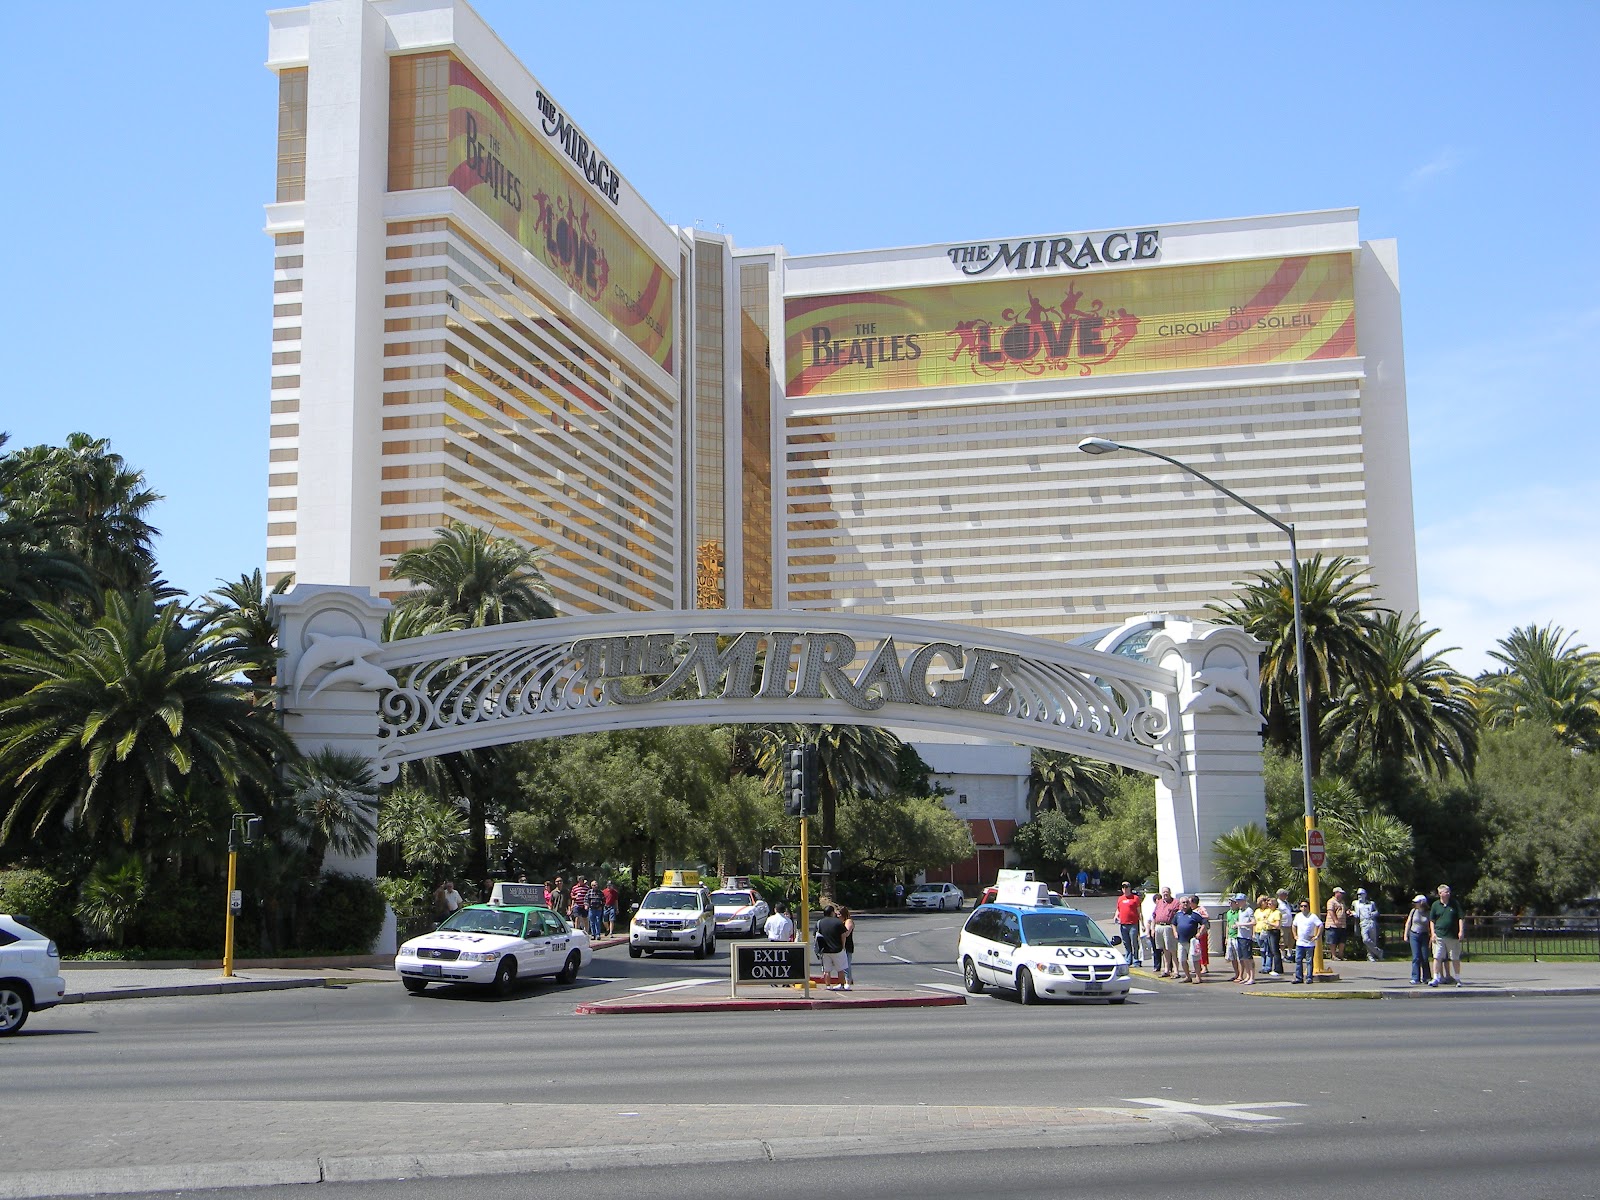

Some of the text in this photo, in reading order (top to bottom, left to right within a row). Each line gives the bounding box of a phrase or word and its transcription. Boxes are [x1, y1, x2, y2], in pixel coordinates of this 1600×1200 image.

[489, 133, 501, 156] THE
[536, 90, 619, 205] THE MIRAGE
[466, 111, 522, 213] BEATLES
[545, 204, 598, 292] LOVE
[947, 230, 1159, 275] THE MIRAGE
[1158, 314, 1312, 337] CIRQUE DU SOLEIL
[1229, 304, 1247, 316] BY
[855, 322, 877, 336] THE
[978, 316, 1107, 364] LOVE
[811, 326, 922, 370] BEATLES
[571, 631, 1020, 711] THE MIRAGE
[753, 949, 790, 963] EXIT
[1055, 947, 1116, 961] 4603
[751, 965, 792, 979] ONLY
